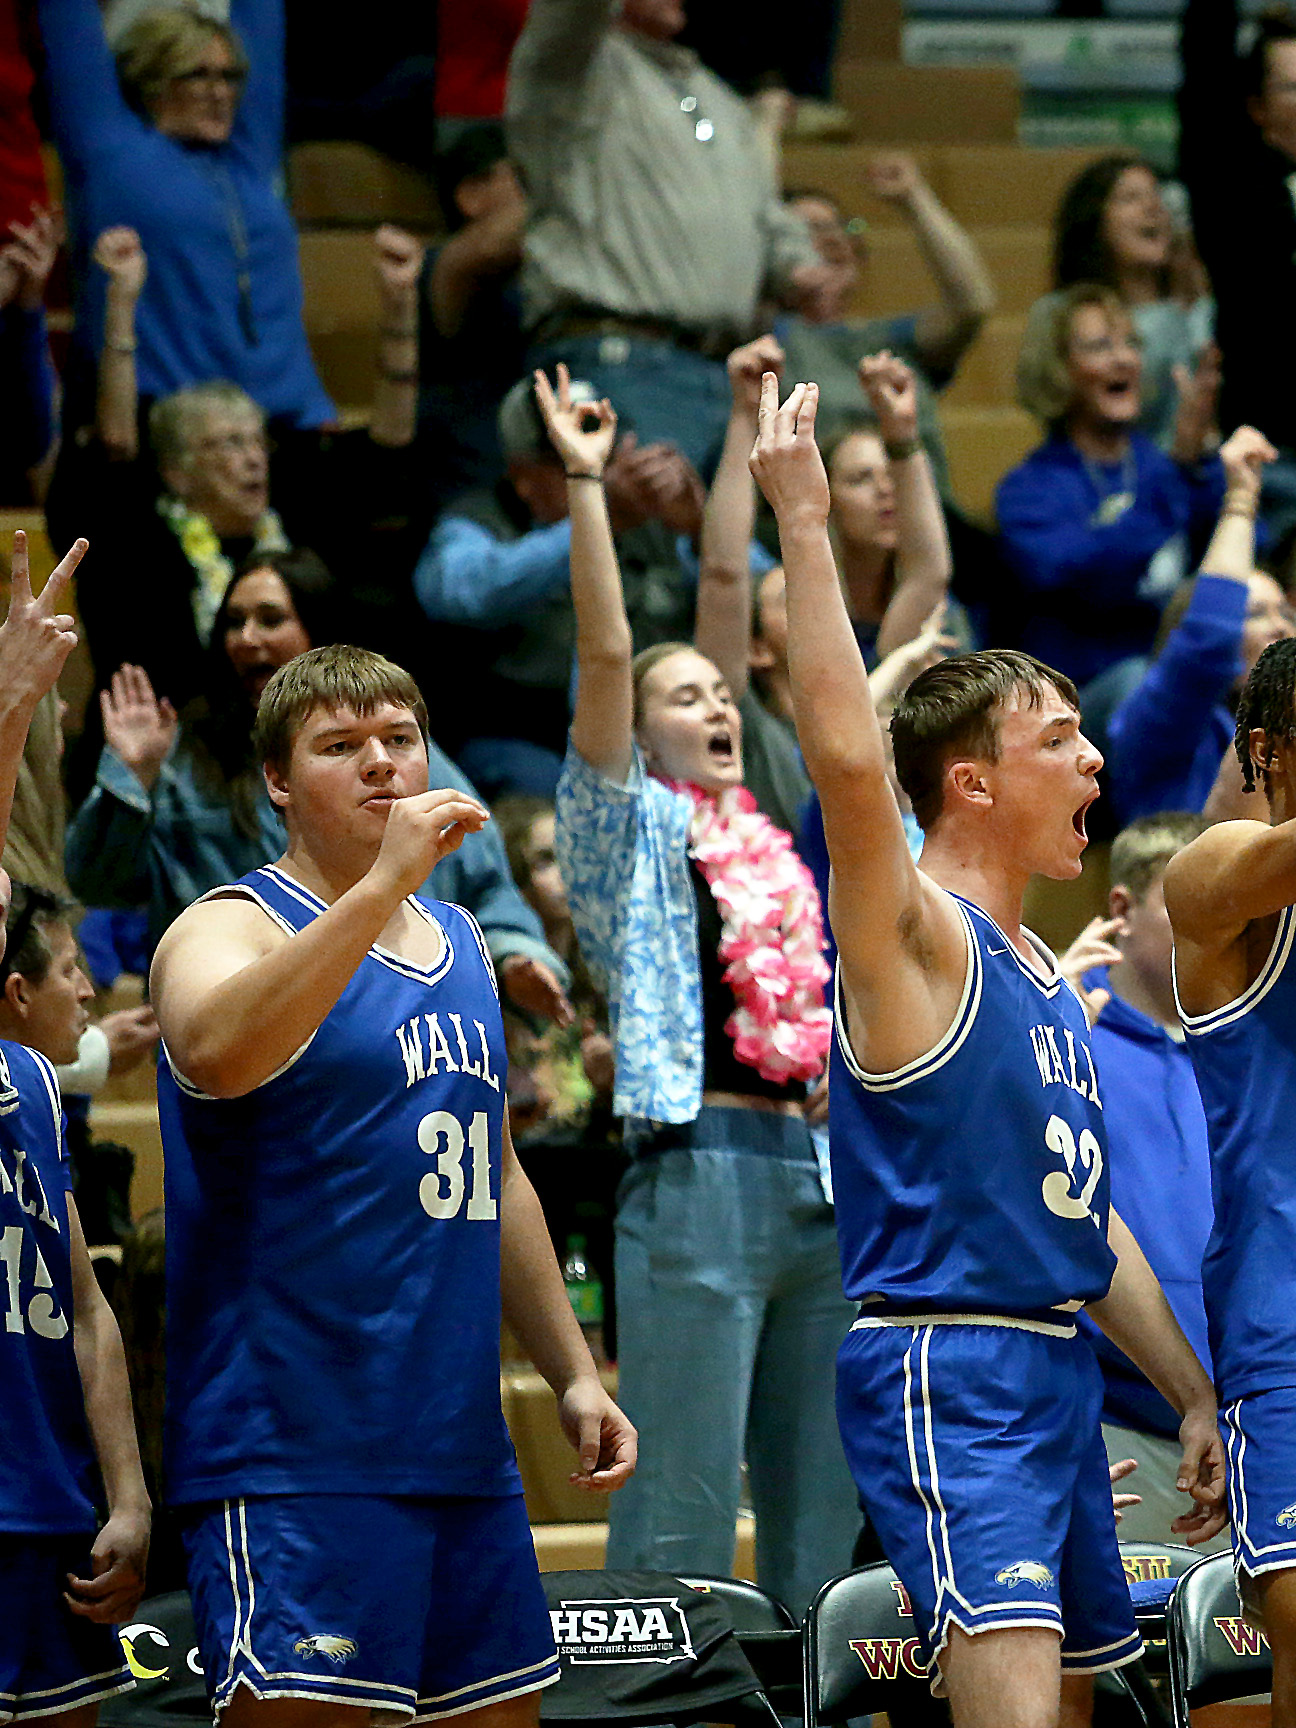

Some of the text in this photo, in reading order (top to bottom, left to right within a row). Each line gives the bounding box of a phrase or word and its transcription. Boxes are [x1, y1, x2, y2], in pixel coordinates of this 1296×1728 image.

[395, 1012, 500, 1093] WALL
[417, 1110, 497, 1221] 31
[589, 1643, 627, 1654] ACTIVITIES
[627, 1641, 674, 1653] ASSOCIATION
